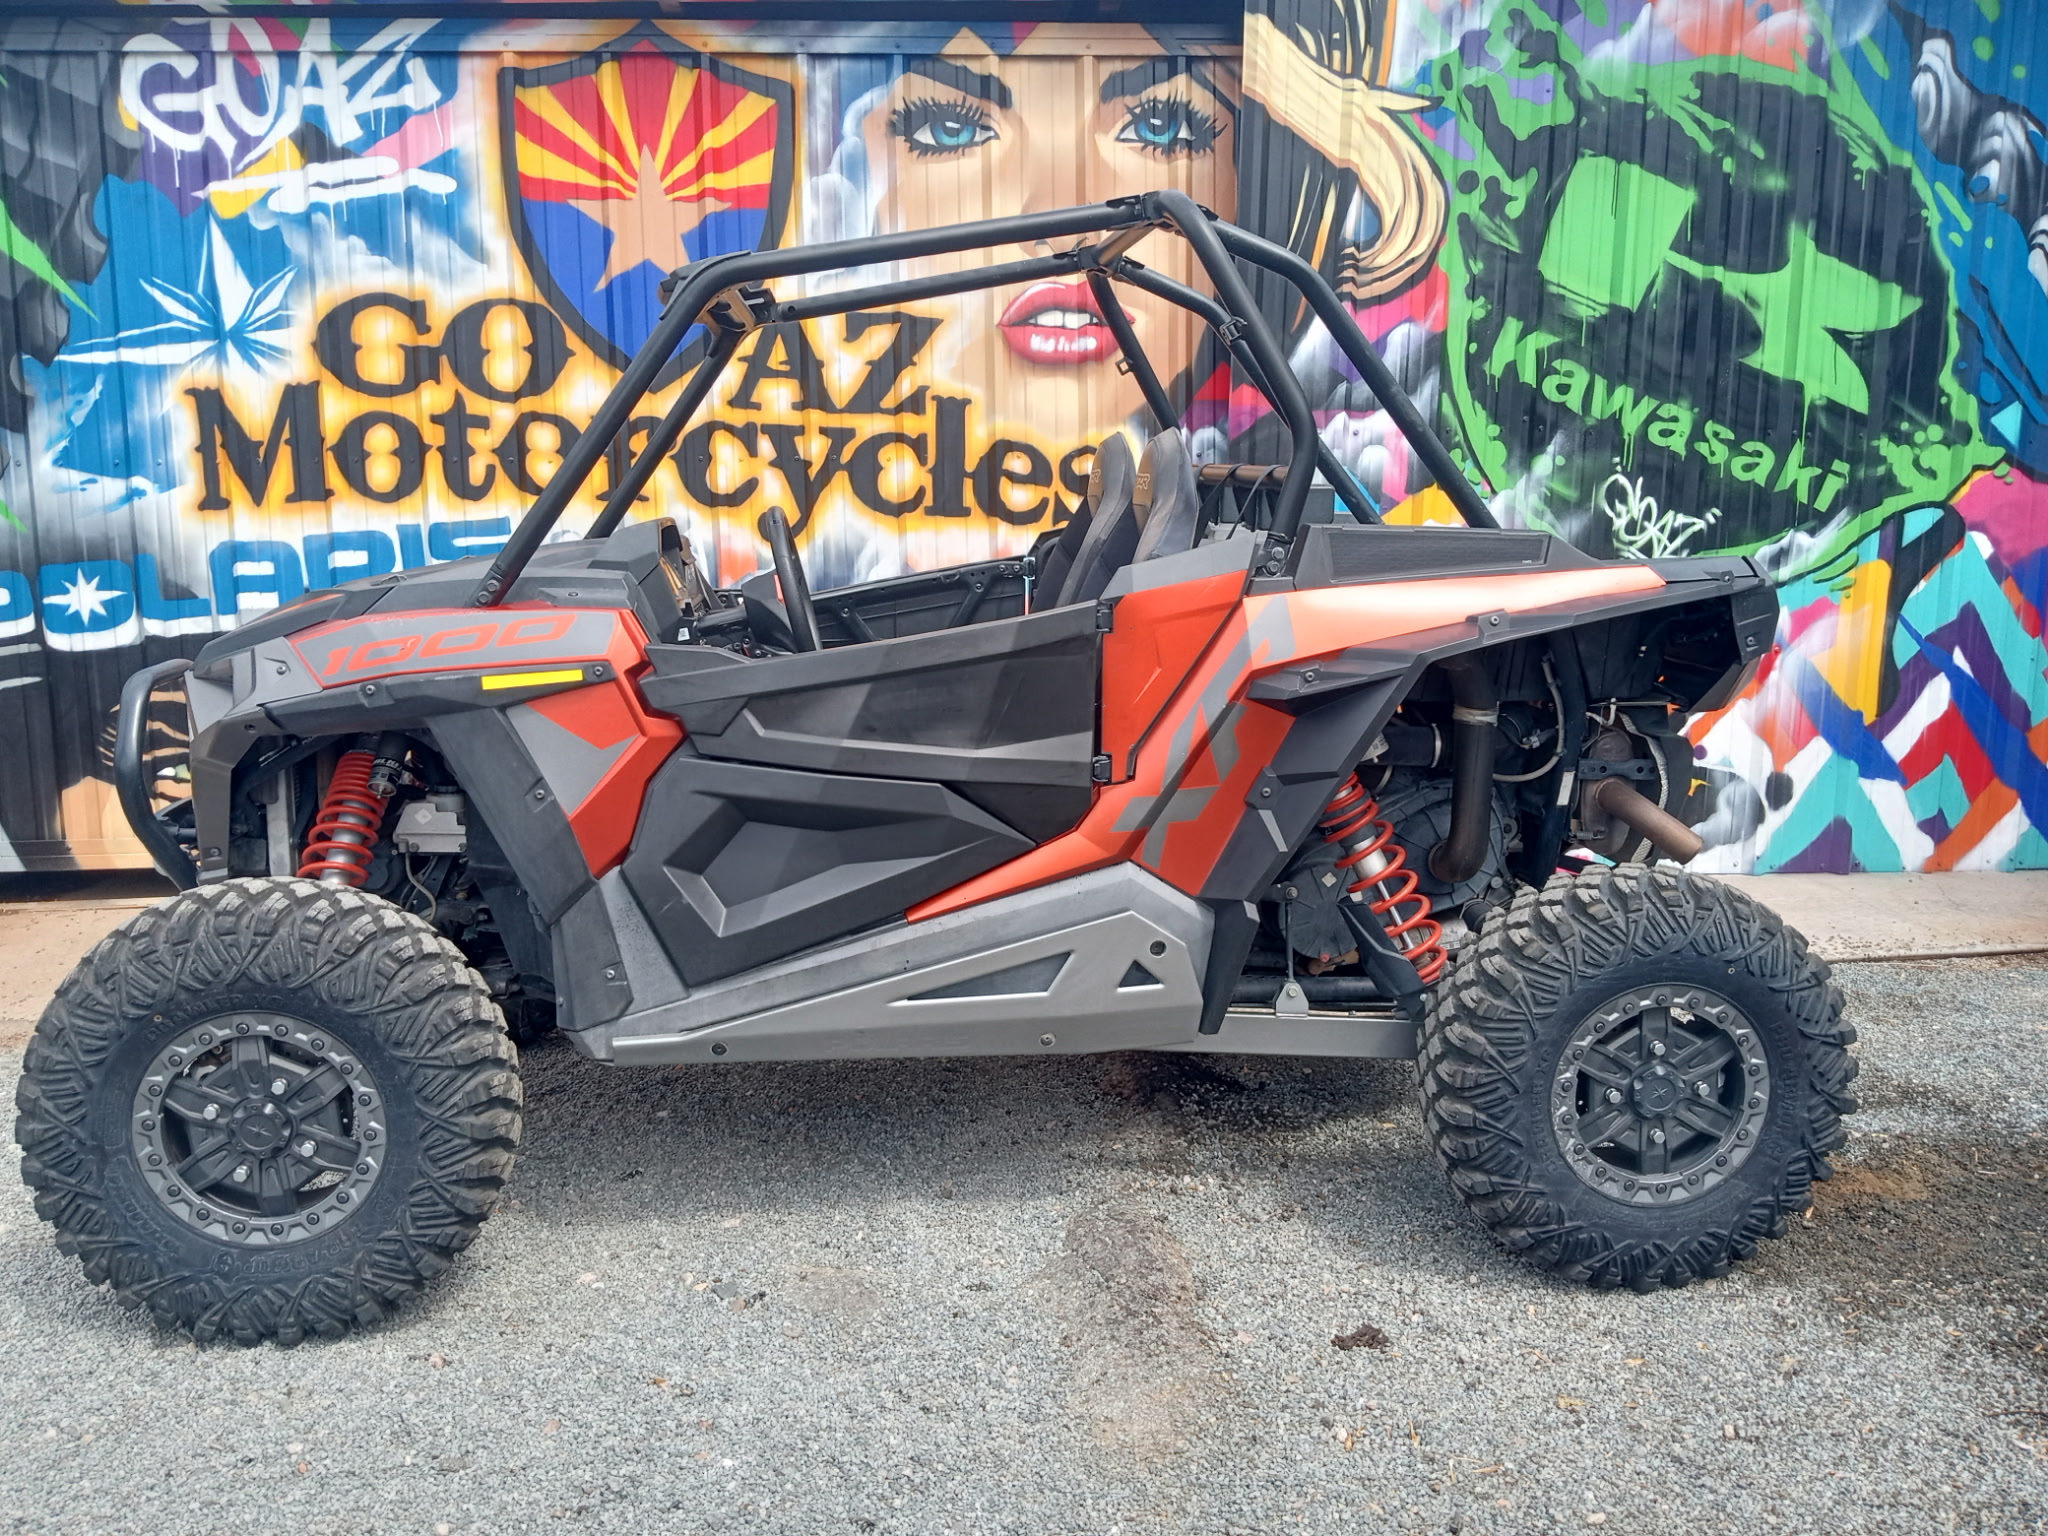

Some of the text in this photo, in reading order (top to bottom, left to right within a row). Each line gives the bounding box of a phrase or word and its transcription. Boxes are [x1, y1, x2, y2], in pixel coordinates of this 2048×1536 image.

[311, 291, 944, 416] GO AZ
[1484, 315, 1850, 512] Kawasaki
[322, 613, 578, 677] 1000
